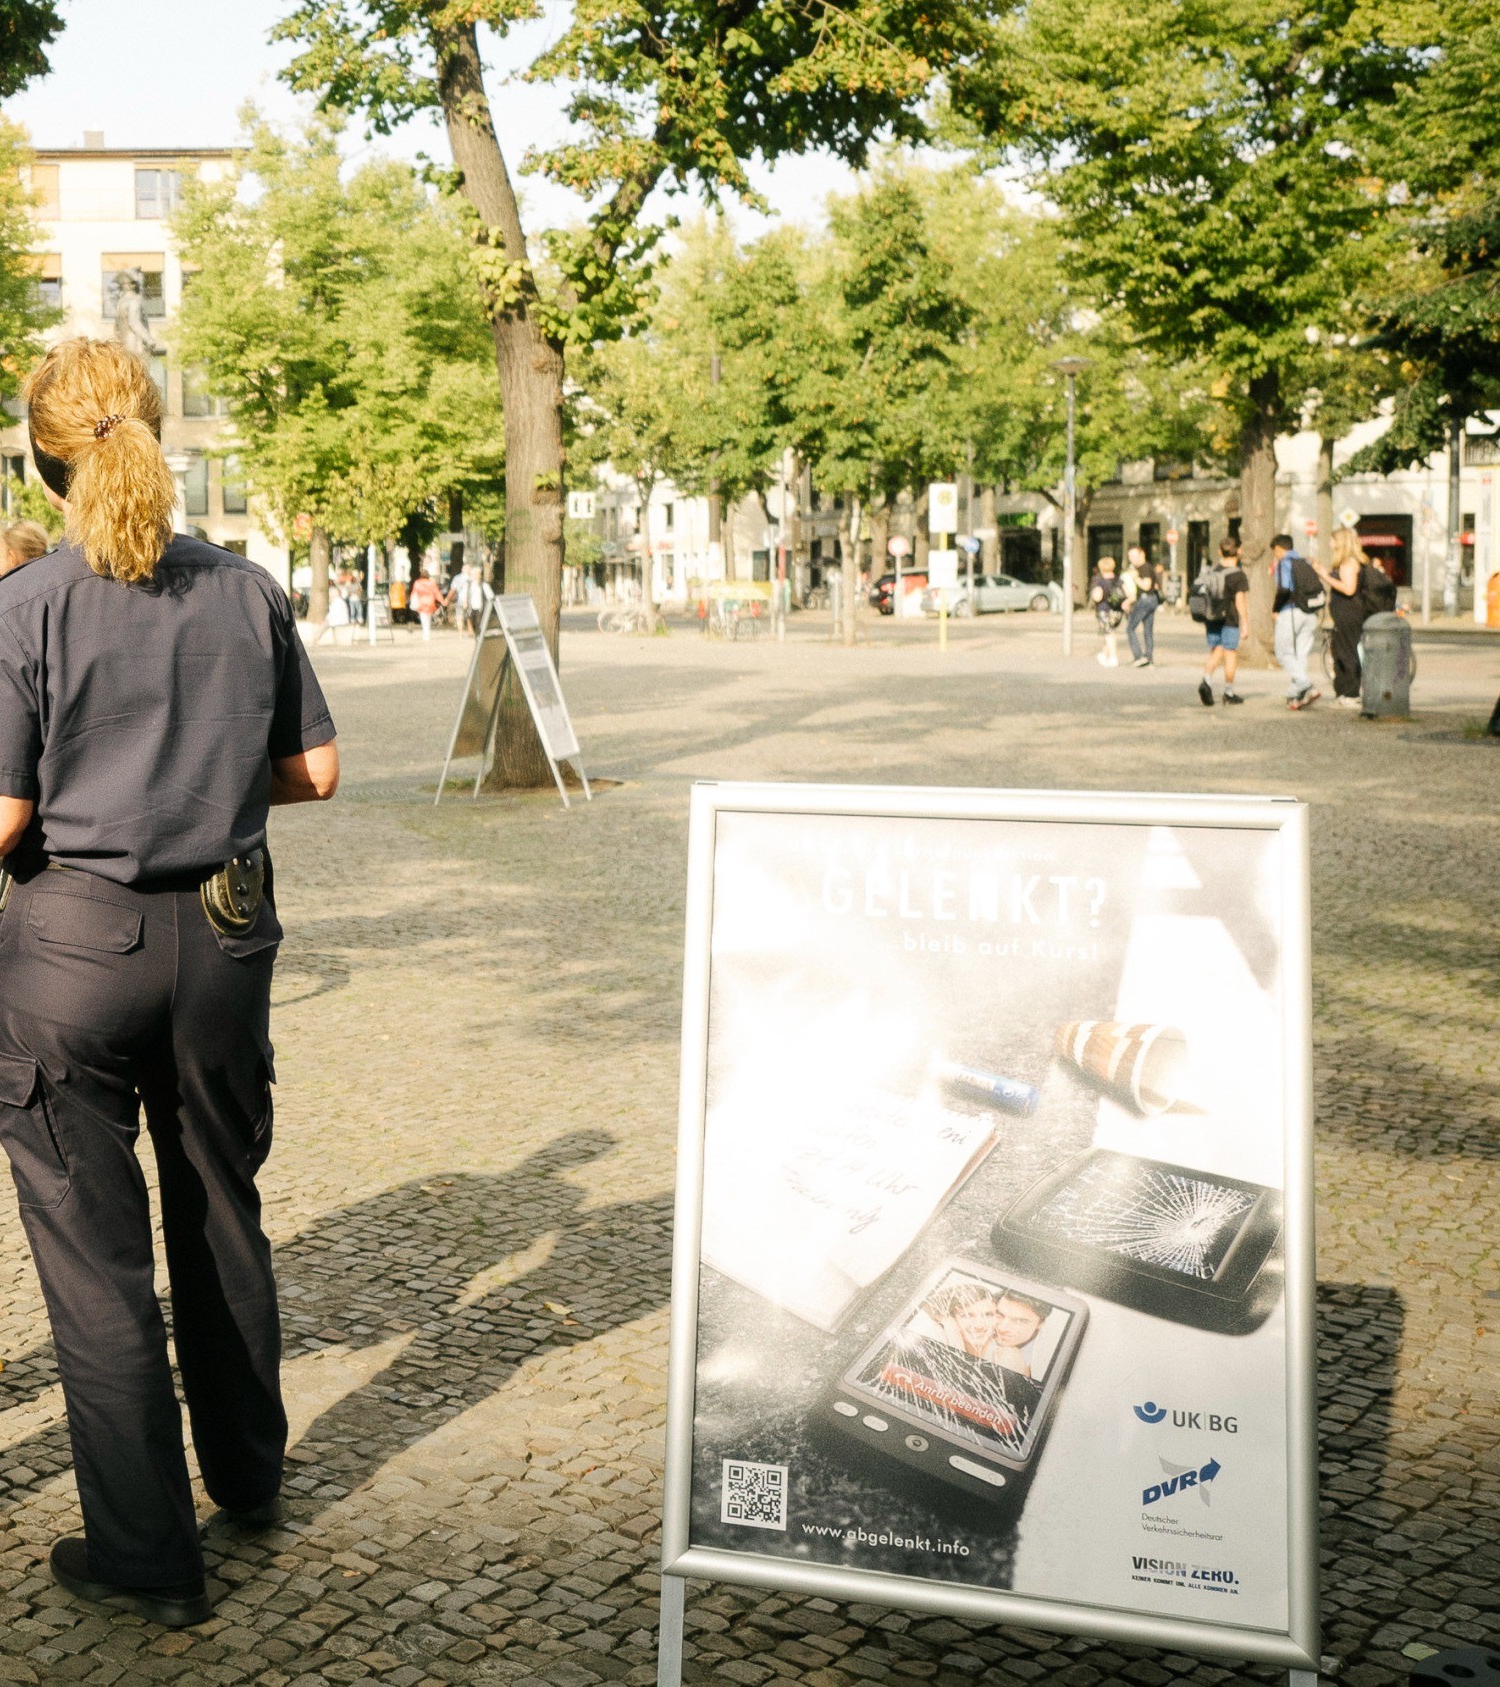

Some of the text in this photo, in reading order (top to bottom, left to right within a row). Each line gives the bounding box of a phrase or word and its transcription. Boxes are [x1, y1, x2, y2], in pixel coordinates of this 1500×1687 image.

[978, 937, 1021, 957] auf
[1032, 938, 1098, 961] Kurs!
[915, 1381, 1002, 1425] Anruf beenden
[1172, 1409, 1238, 1434] UK BG
[1142, 1469, 1199, 1506] DVR
[1141, 1512, 1179, 1524] Deutscher
[802, 1523, 970, 1556] www.abgelenkt.info
[1141, 1523, 1223, 1541] Verkehrssicherheitsrat
[1132, 1556, 1240, 1585] VISION ZERO.
[1153, 1577, 1174, 1585] KOMMT
